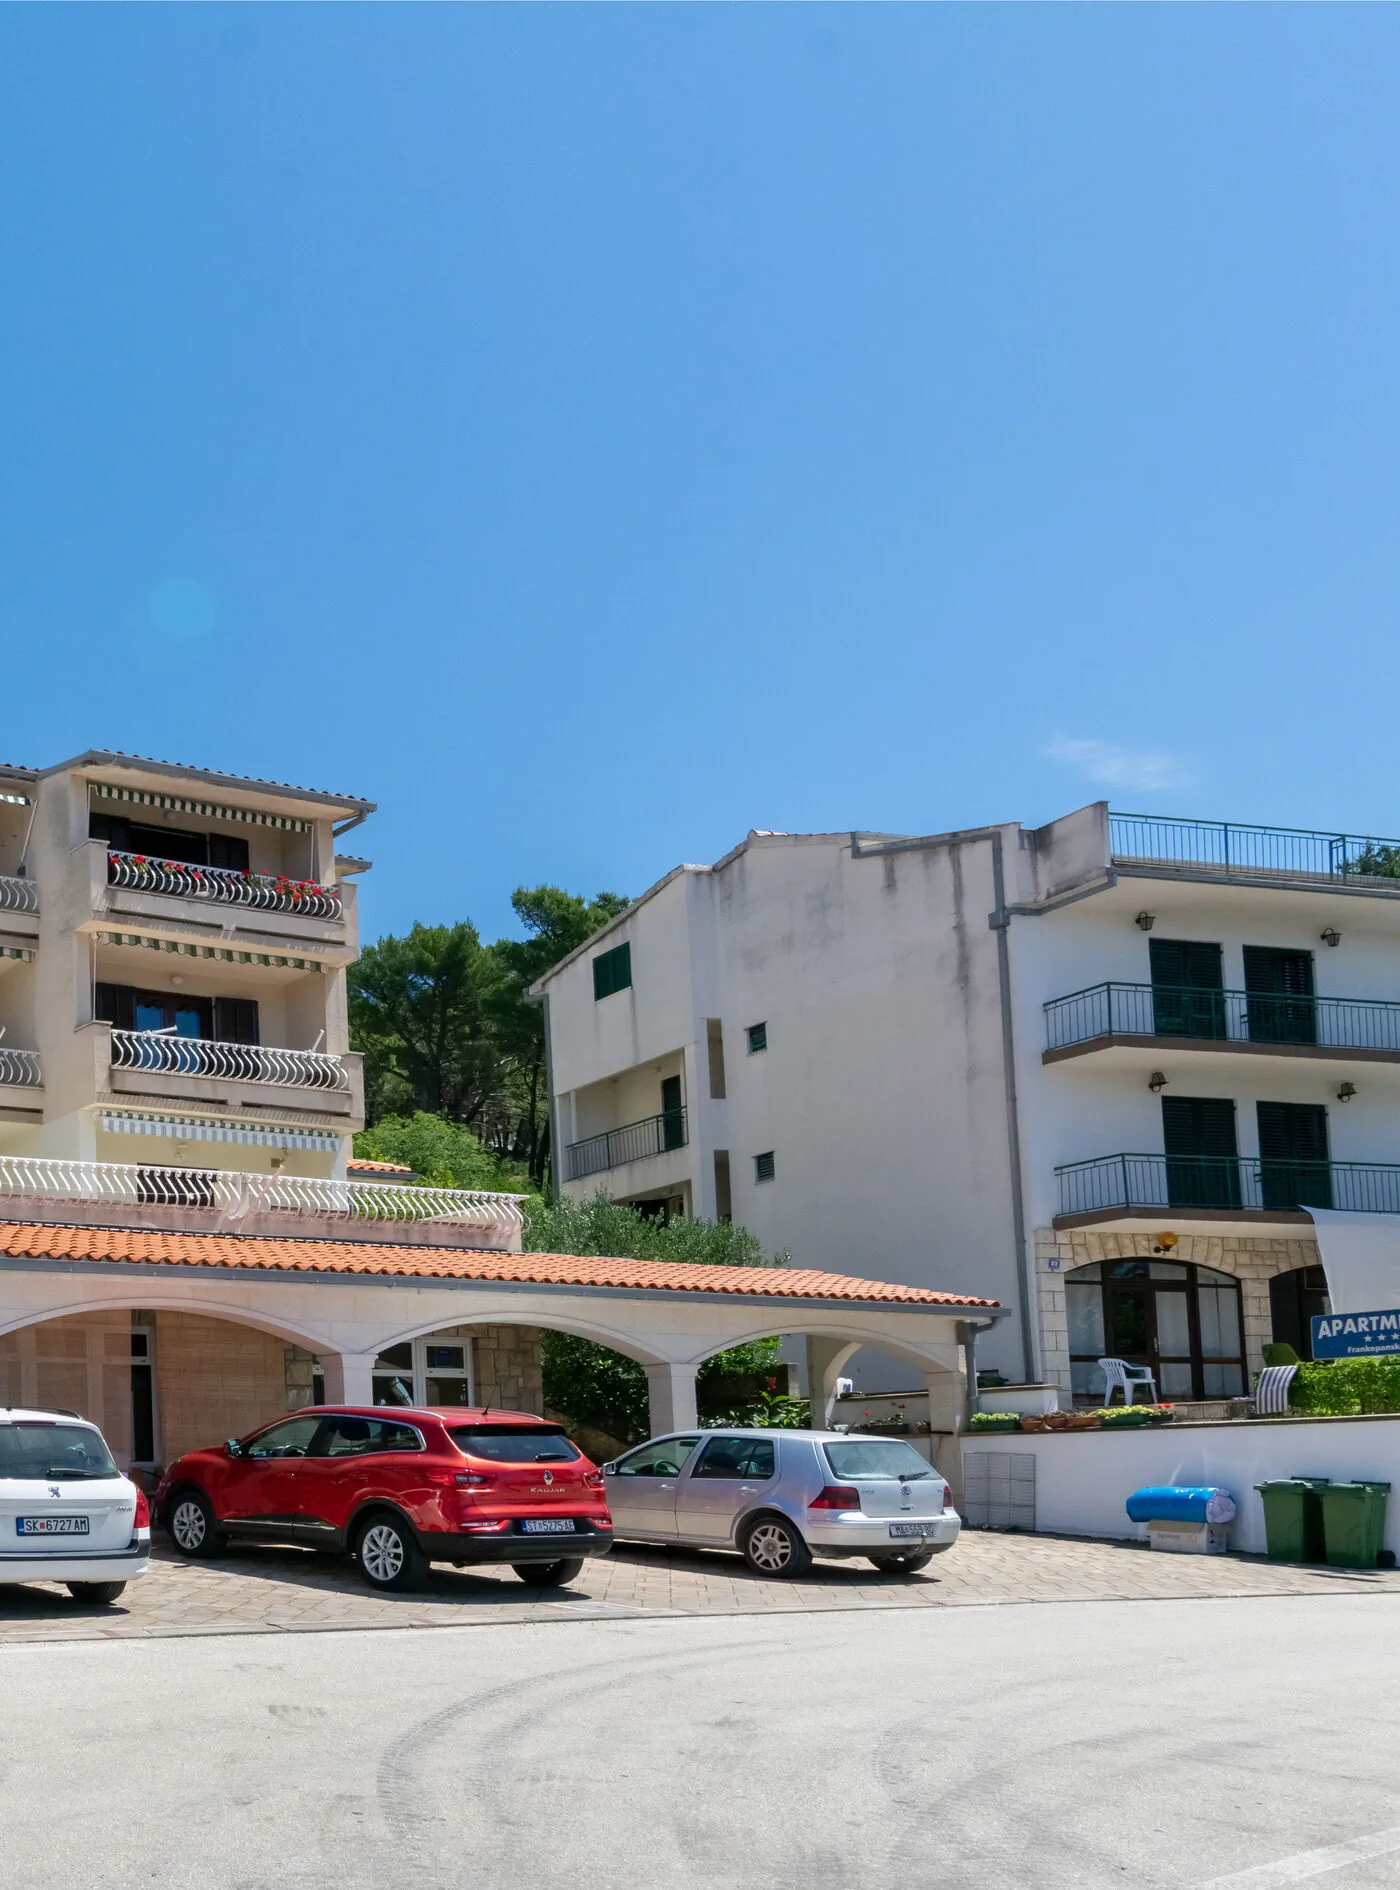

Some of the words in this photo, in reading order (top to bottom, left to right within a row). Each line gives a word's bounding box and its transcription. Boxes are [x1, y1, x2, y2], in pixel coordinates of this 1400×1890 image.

[1318, 1314, 1400, 1340] APARTM
[1347, 1342, 1400, 1354] Frankopansk
[25, 1520, 39, 1532] SK
[46, 1519, 72, 1531] 6727
[74, 1519, 87, 1531] AM
[527, 1520, 537, 1531] ST
